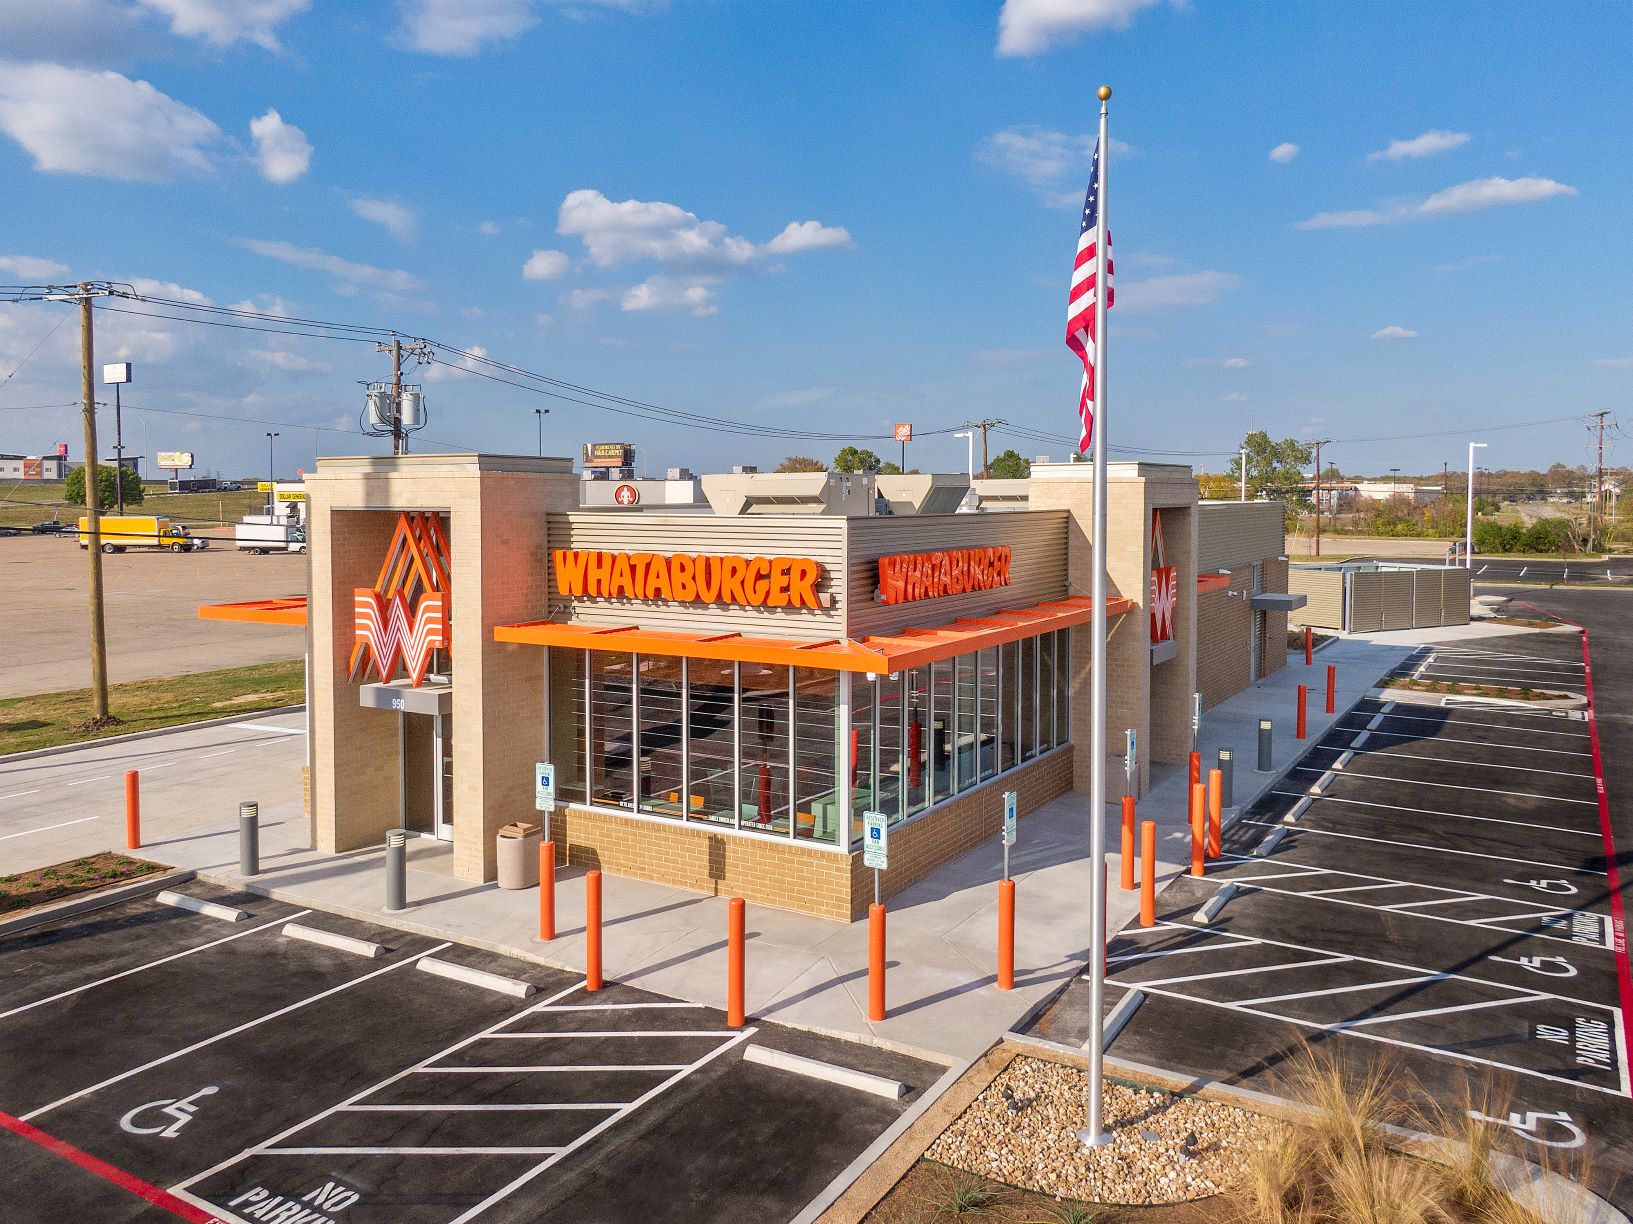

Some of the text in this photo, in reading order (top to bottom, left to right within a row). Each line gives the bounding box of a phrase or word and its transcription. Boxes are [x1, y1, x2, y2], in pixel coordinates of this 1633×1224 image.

[552, 549, 822, 610] WHATABURGER
[878, 545, 1012, 606] WHATABURGER
[392, 698, 405, 709] 950
[1535, 1024, 1569, 1045] NO
[1574, 1017, 1612, 1070] PARKING
[301, 1181, 361, 1212] NO
